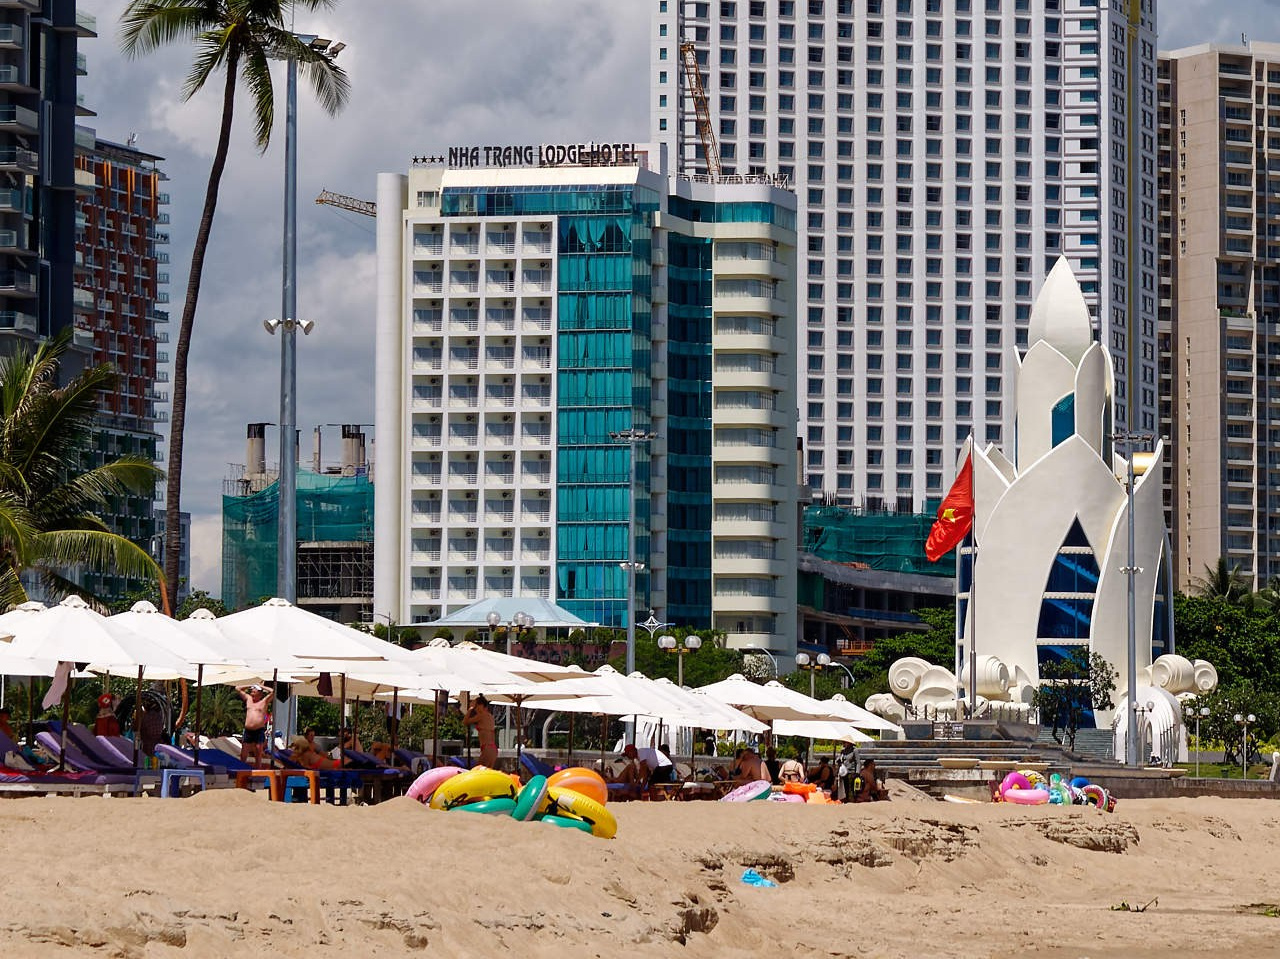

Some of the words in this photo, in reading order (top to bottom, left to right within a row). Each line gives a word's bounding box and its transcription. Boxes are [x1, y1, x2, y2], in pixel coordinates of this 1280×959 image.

[448, 147, 479, 167] NHA
[484, 145, 533, 167] TRANG
[539, 144, 585, 165] LODGE
[591, 143, 638, 164] HOTEL
